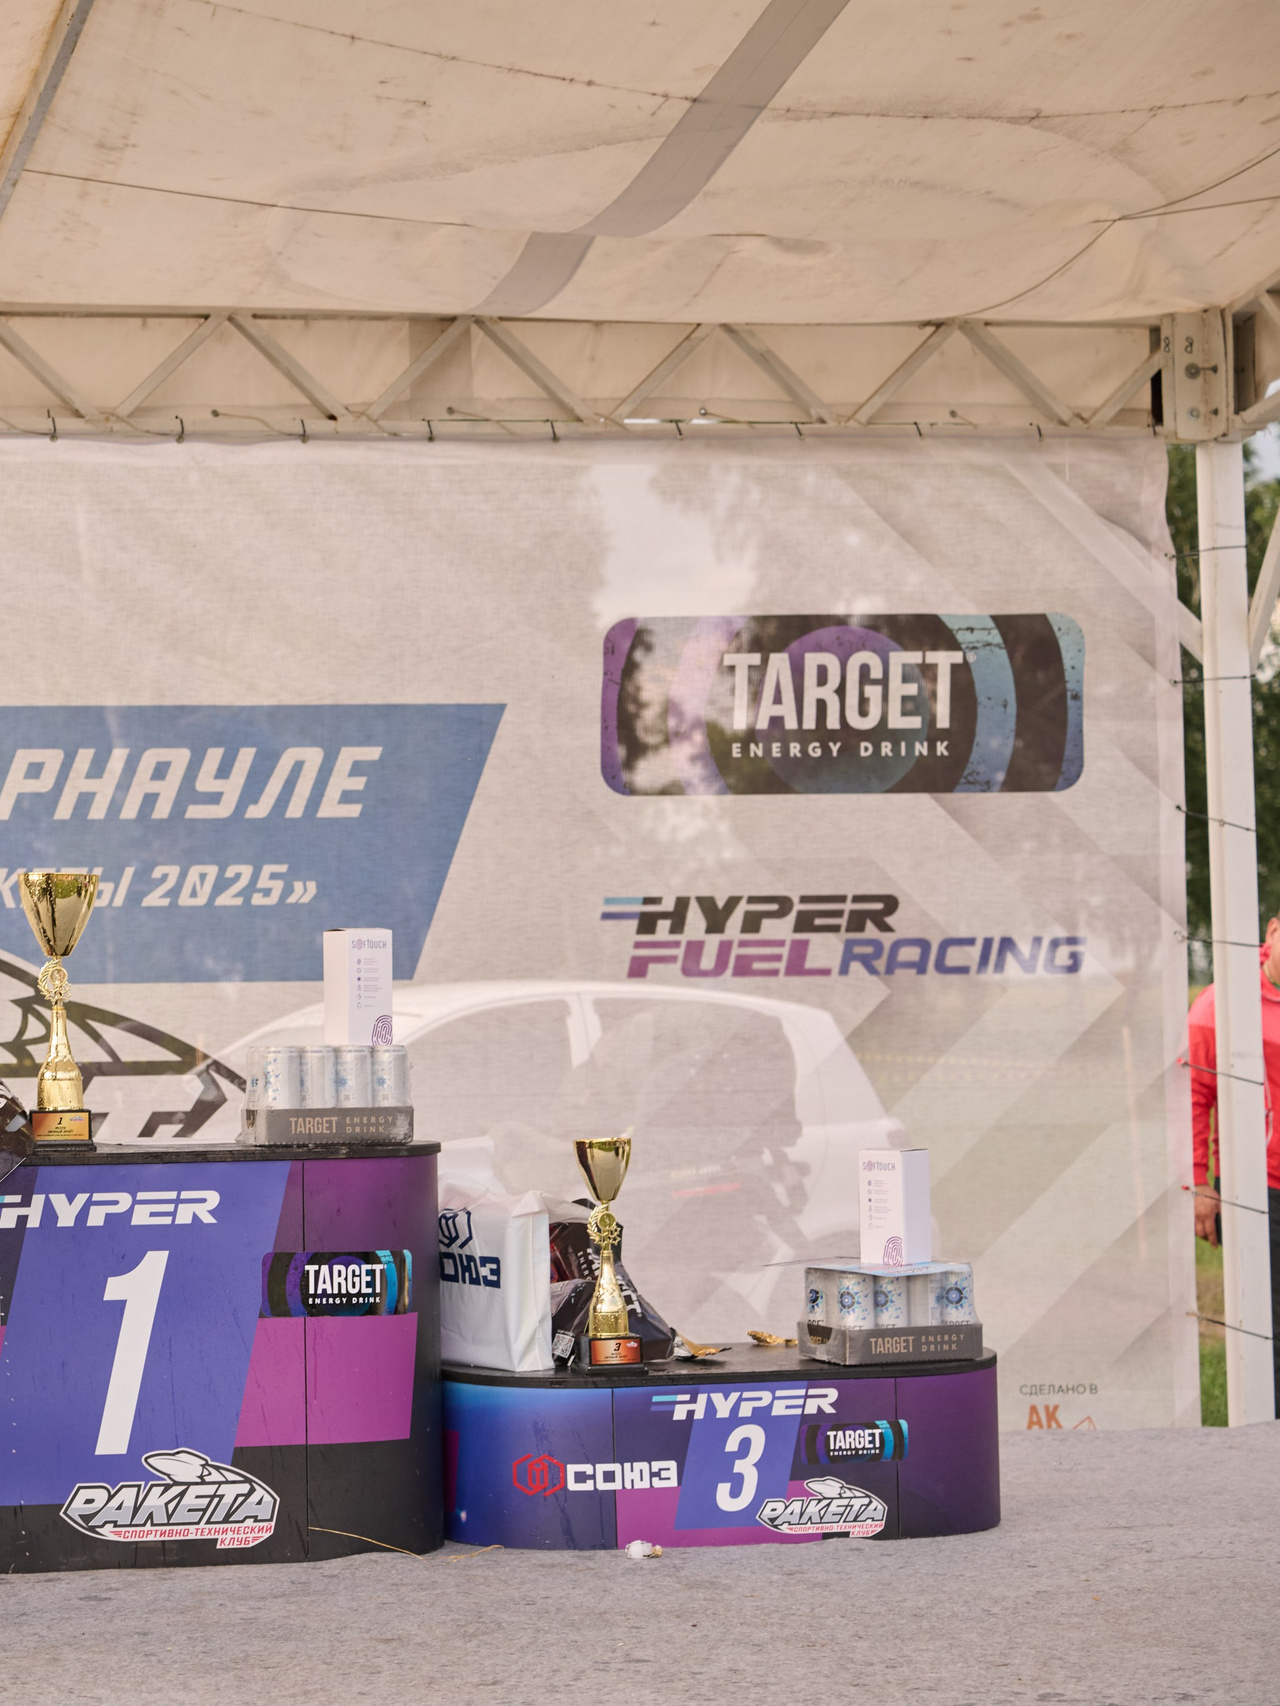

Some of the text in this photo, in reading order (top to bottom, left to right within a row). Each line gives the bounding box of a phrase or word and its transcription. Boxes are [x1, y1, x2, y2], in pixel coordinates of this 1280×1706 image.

[723, 650, 964, 730] TARGET
[731, 740, 951, 758] ENERGY DRINK
[142, 864, 318, 907] 2025»
[636, 894, 900, 936] HYPER
[626, 935, 1086, 978] FUEL RACING
[289, 1116, 394, 1134] TARGET ENERGY
[346, 1126, 386, 1134] DRINK
[305, 1264, 384, 1294] TARGET
[95, 1250, 169, 1455] 1
[614, 1343, 621, 1351] 3
[869, 1334, 966, 1354] TARGET ENERGY
[921, 1343, 957, 1352] DRINK
[1019, 1384, 1098, 1396] СДЕЛАНО В
[673, 1388, 839, 1421] HYPER
[827, 1429, 882, 1449] TARGET
[567, 1460, 678, 1490] СОЮЗ
[715, 1424, 766, 1512] 3
[66, 1483, 275, 1528] РАКЕТА
[760, 1498, 885, 1527] РАКЕТА
[123, 1523, 273, 1540] СПОРТИВНО-ТЕХНИЧЕСКИЙ
[793, 1522, 884, 1532] СПОРТИВНО-ТЕХНИЧЕСКИЙ
[219, 1536, 251, 1547] КЛУБ
